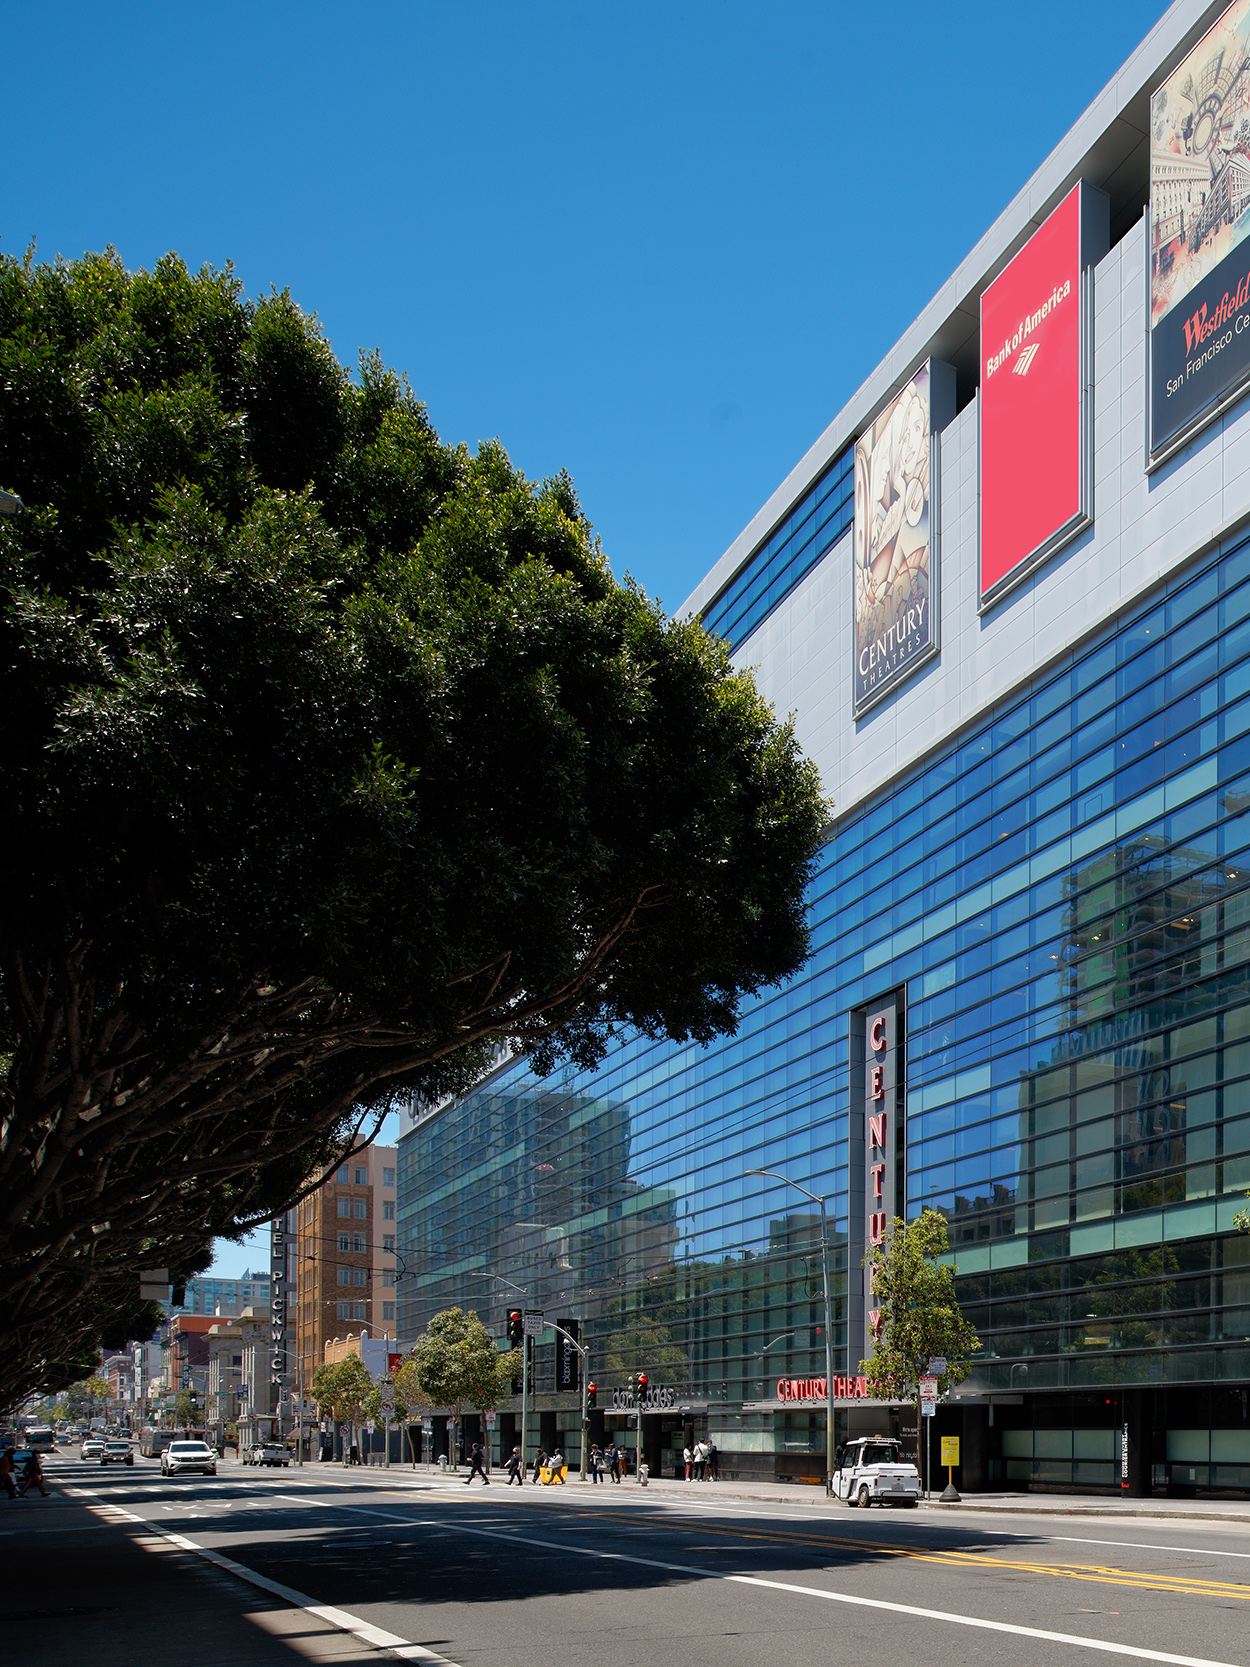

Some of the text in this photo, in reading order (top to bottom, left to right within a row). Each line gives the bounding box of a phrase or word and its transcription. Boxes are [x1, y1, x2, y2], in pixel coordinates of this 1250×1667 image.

[987, 279, 1071, 380] Bank of America
[1166, 373, 1184, 398] San
[1186, 330, 1232, 380] Francisco
[859, 597, 926, 676] CENTURY
[863, 632, 921, 691] THEATRES
[272, 1218, 283, 1258] TEL
[270, 1270, 284, 1386] PICKWICK
[777, 1378, 828, 1401] CENTURY
